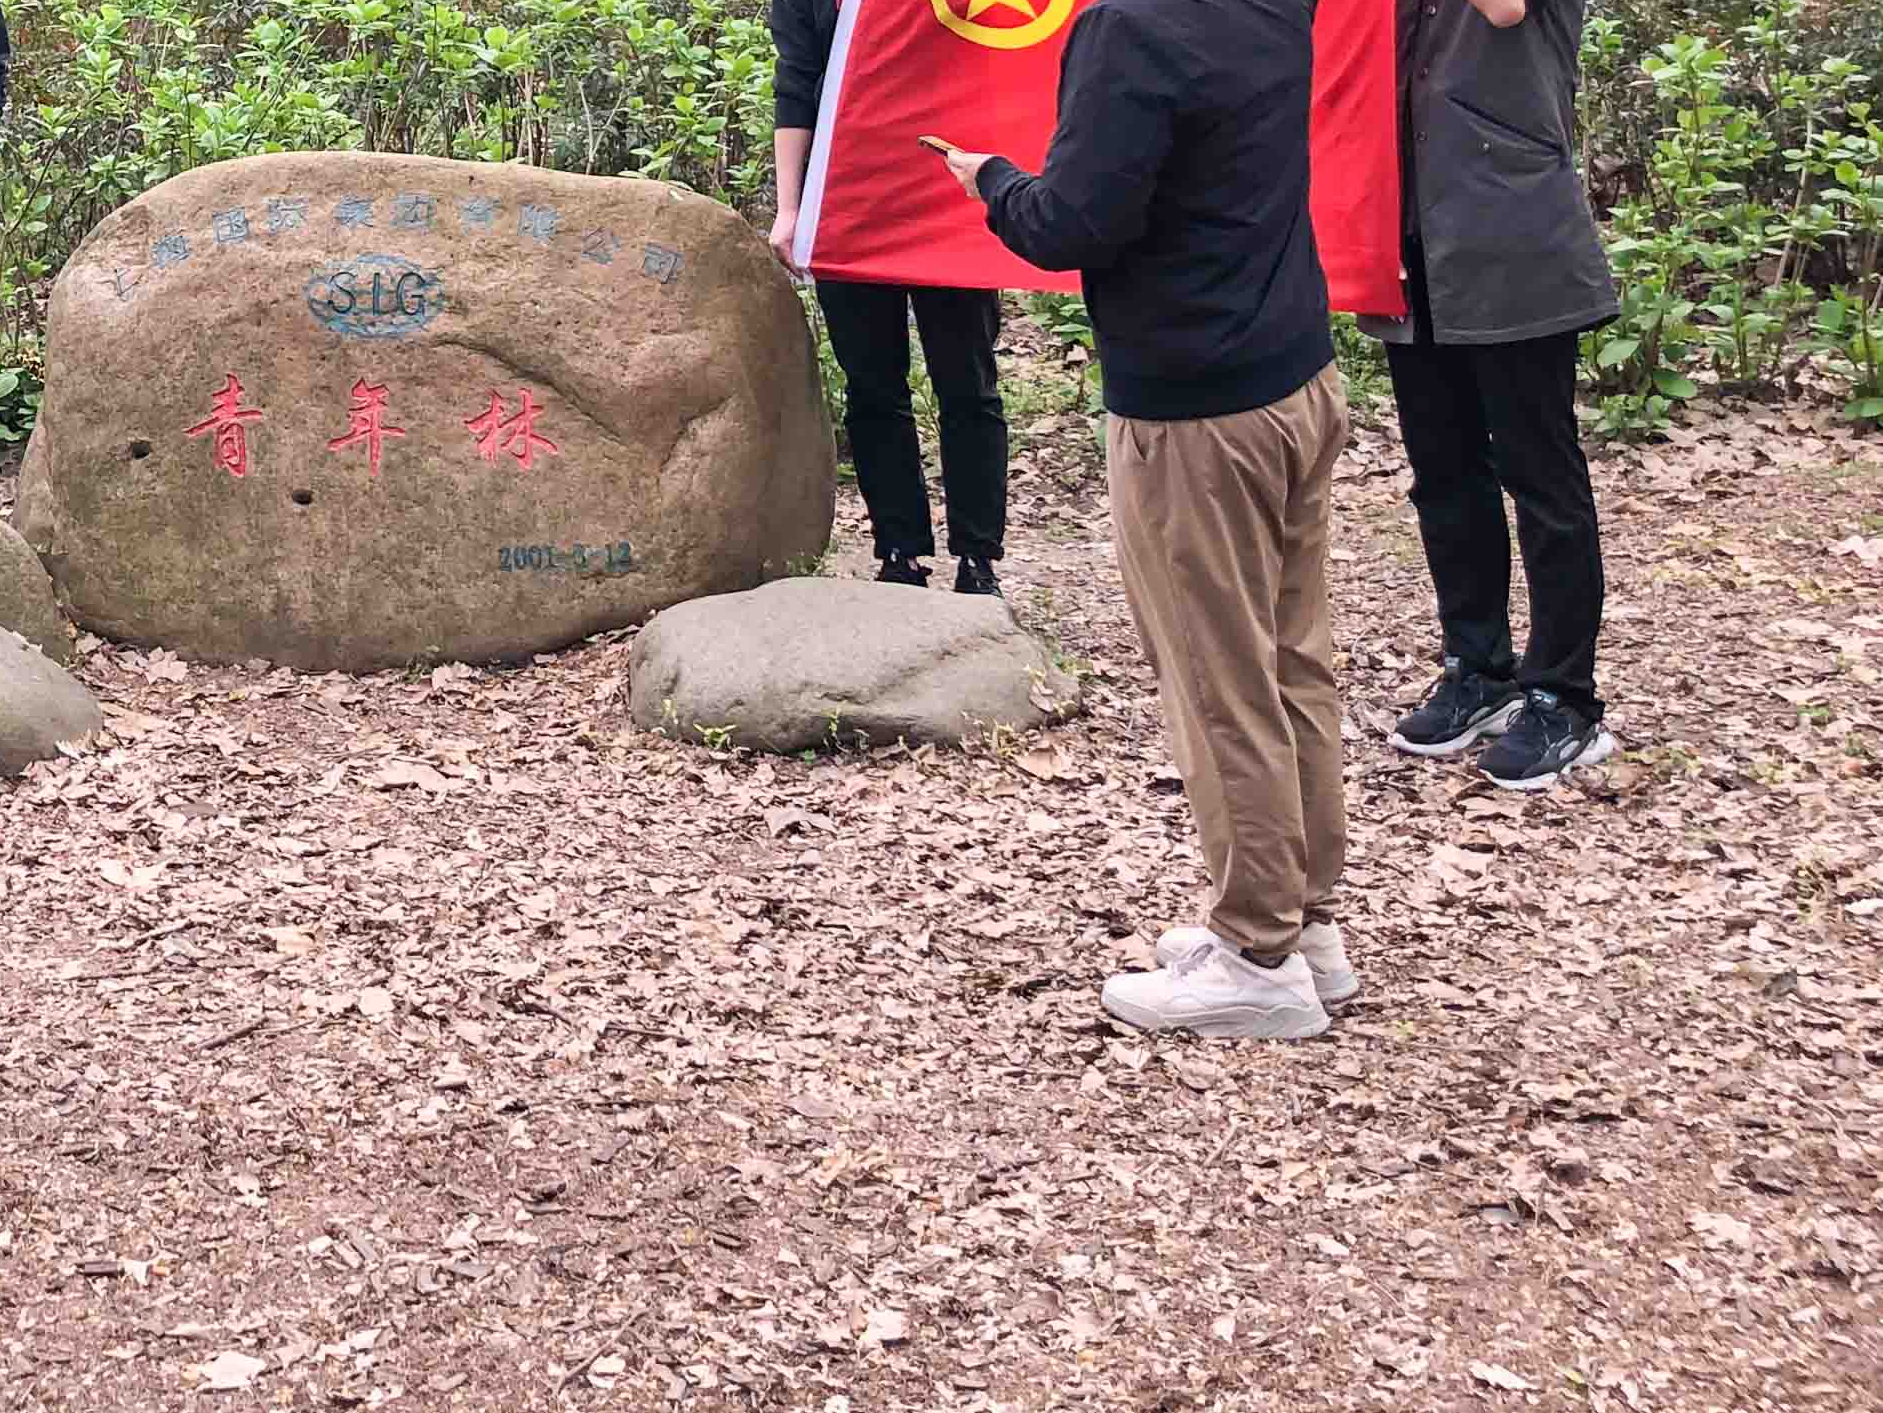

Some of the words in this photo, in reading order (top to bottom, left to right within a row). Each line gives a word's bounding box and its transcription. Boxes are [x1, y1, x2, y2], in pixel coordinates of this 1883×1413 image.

[326, 270, 425, 316] SIG
[182, 373, 559, 477] 青年林
